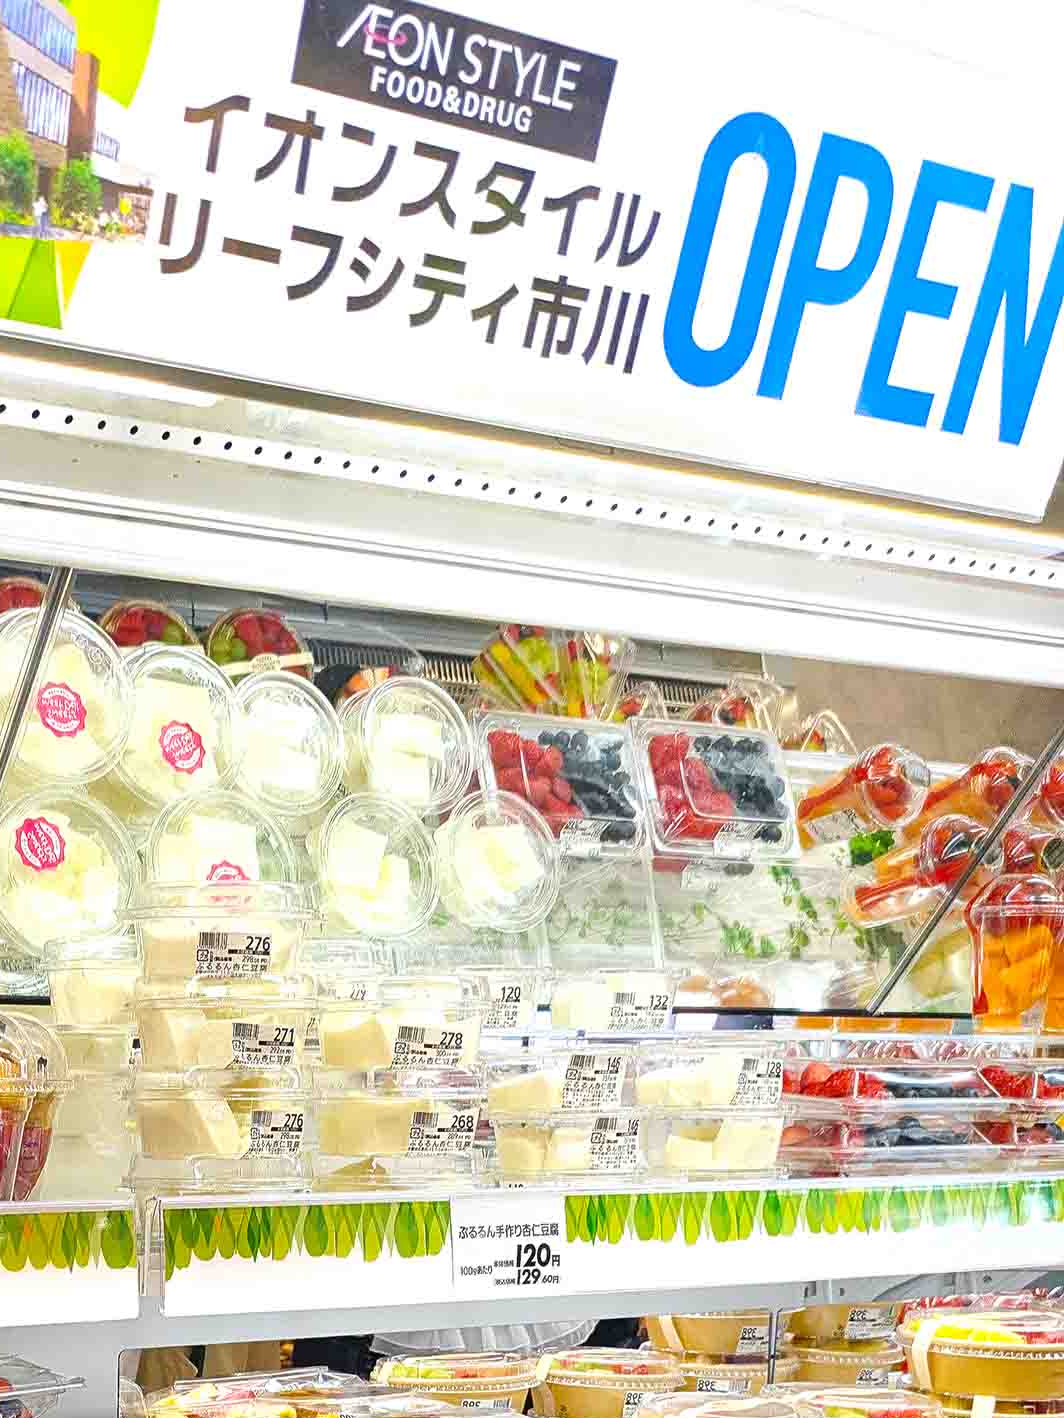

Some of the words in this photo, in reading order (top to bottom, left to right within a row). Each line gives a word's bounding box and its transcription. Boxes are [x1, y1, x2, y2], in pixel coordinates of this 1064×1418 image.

[458, 33, 582, 112] STYLE
[369, 65, 536, 133] FOOD&DRUG
[184, 95, 661, 268] イオンスタイル
[159, 192, 650, 374] リーフシティ市川
[663, 111, 1064, 446] OPEN
[246, 936, 270, 951] 276
[274, 1028, 295, 1043] 271
[440, 1032, 463, 1047] 278
[285, 1113, 304, 1128] 276
[451, 1115, 474, 1129] 268
